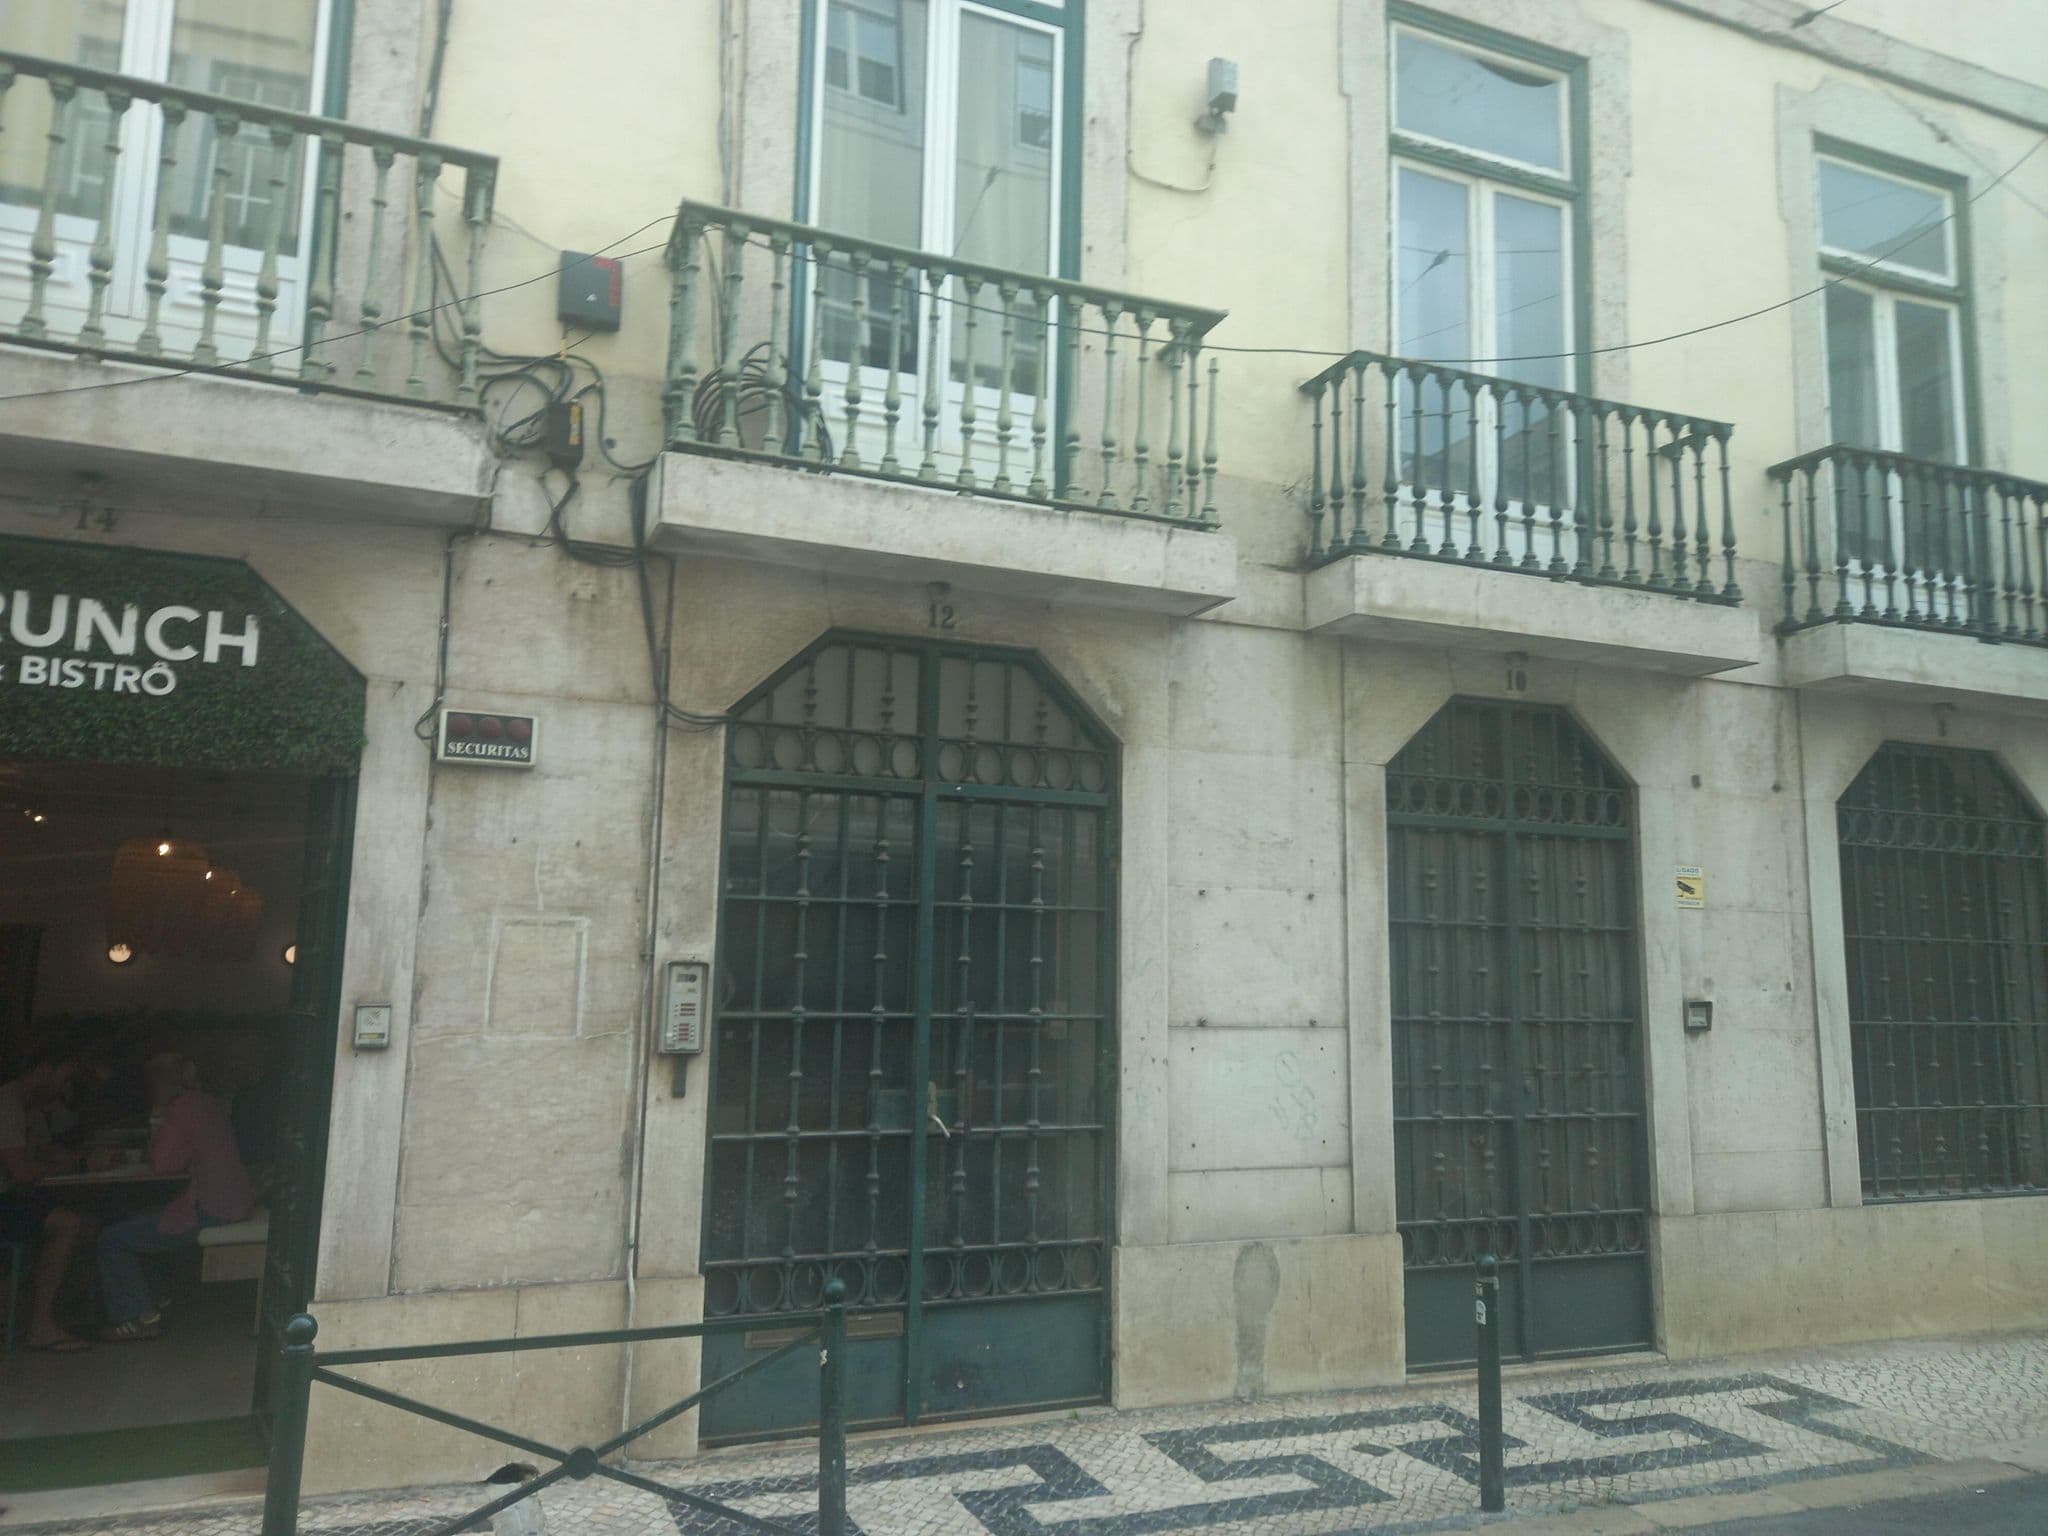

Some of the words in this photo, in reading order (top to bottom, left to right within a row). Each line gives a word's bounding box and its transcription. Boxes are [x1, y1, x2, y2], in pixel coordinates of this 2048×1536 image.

[0, 588, 260, 667] UNCH
[928, 603, 956, 629] 12
[18, 655, 177, 697] BISTRÔ
[1506, 669, 1528, 692] 10
[446, 740, 530, 759] SECURITAS
